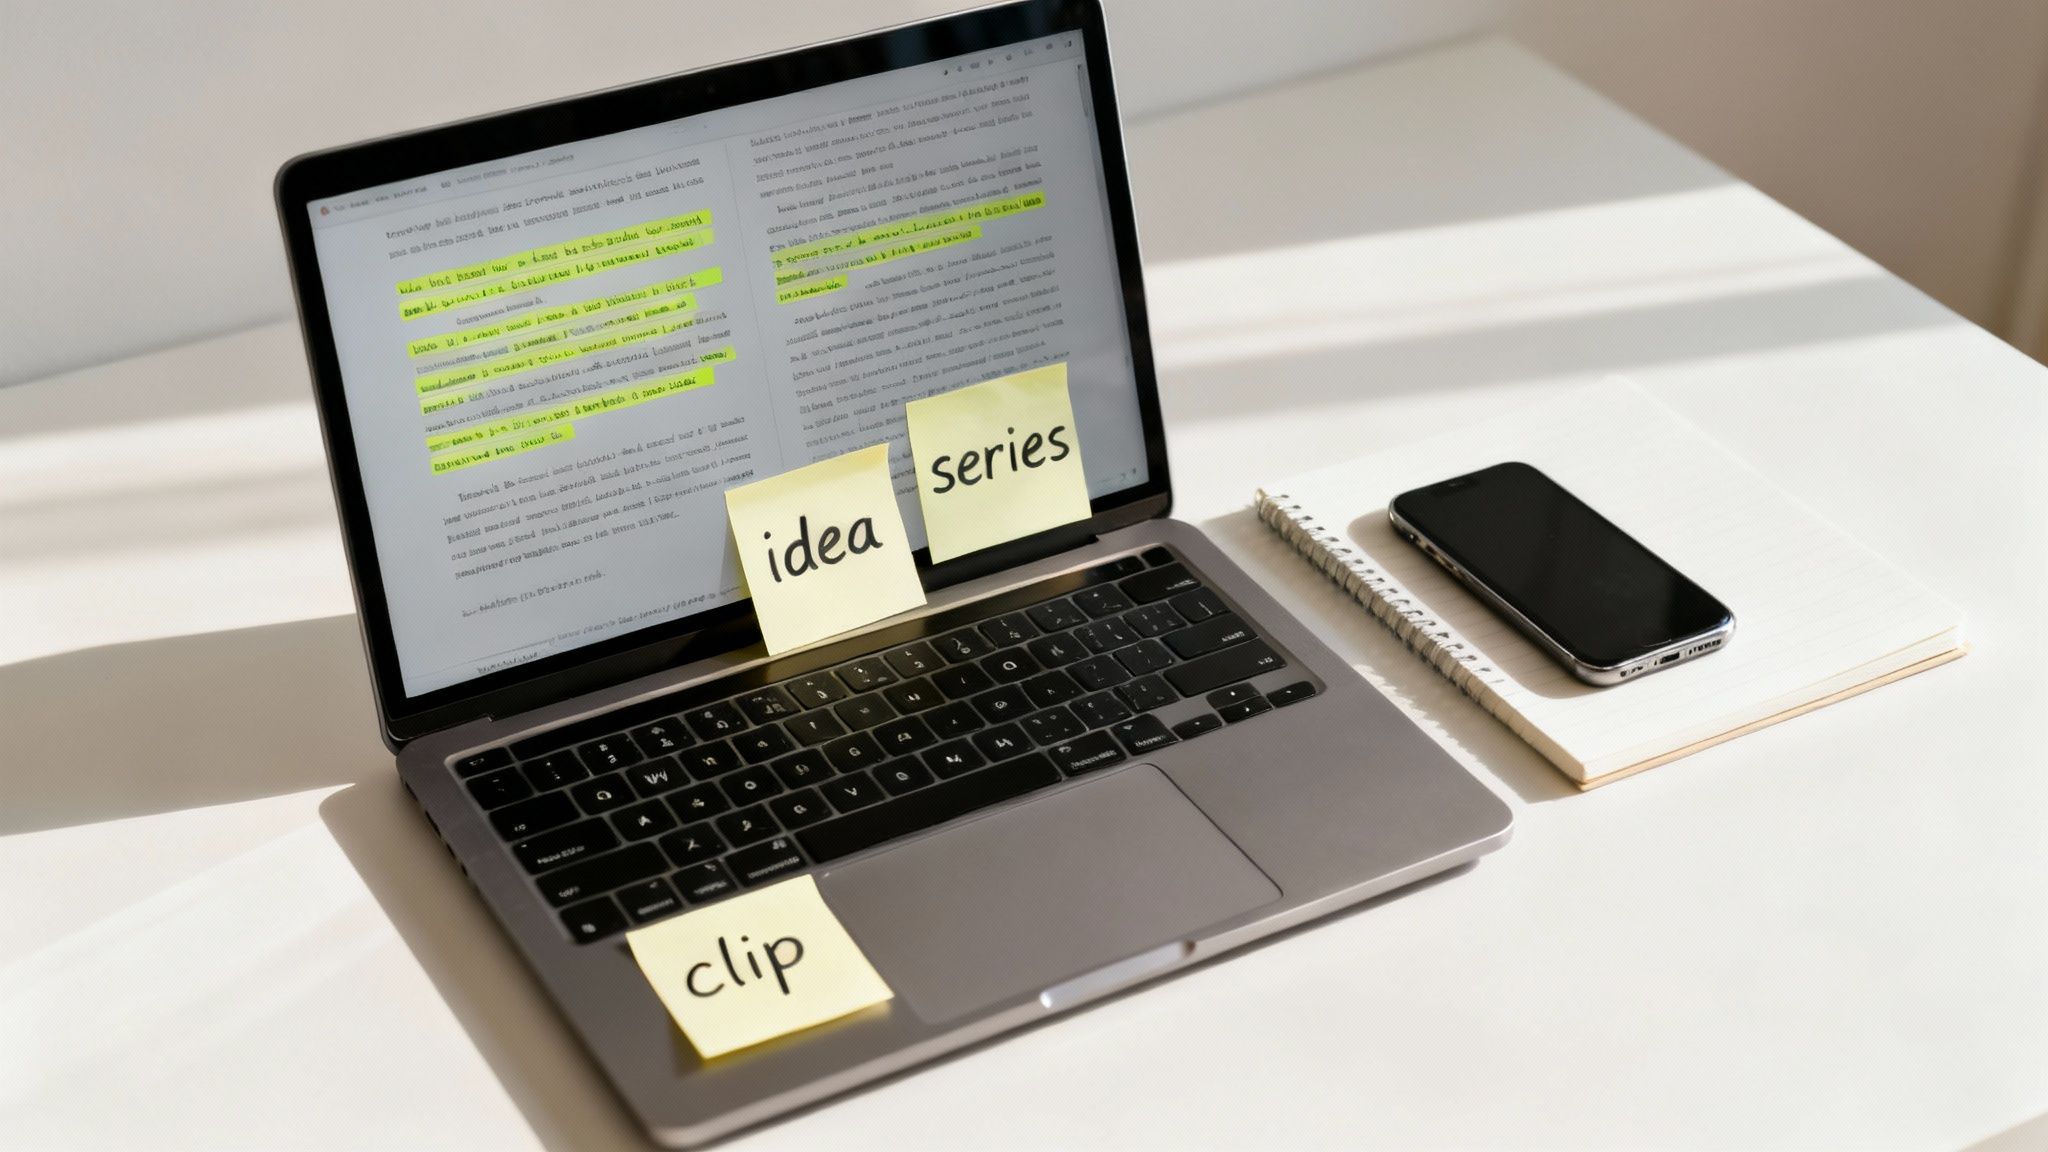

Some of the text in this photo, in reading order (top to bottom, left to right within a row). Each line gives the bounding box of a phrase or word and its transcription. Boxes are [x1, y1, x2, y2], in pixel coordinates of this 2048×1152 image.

[931, 425, 1070, 494] series
[763, 515, 883, 583] idea
[686, 936, 804, 996] clip
